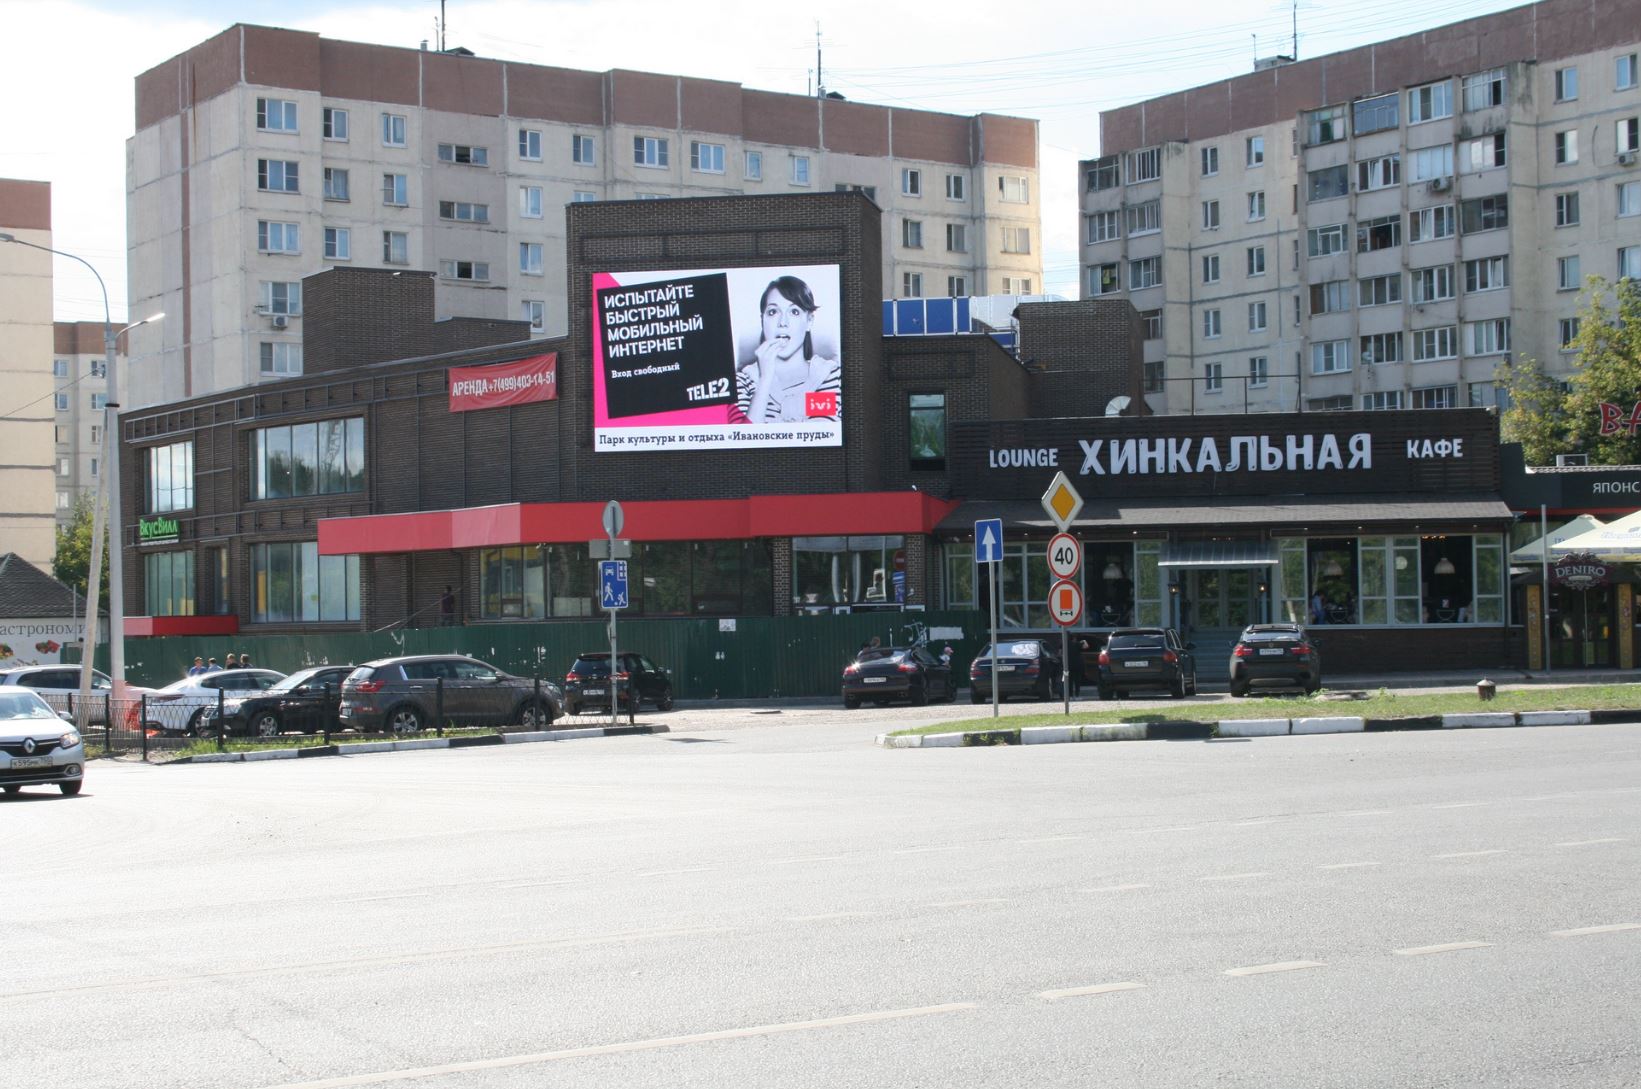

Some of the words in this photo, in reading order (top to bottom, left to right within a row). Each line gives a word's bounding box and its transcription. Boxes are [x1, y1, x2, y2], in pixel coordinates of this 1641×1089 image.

[604, 284, 694, 309] ИСПЫТАЙТЕ
[606, 301, 680, 325] БЫСТРЫЙ
[607, 314, 703, 342] МОБИЛЬНЫЙ
[609, 336, 685, 358] ИНТЕРНЕТ
[611, 369, 632, 379] Вход
[633, 362, 681, 376] свободный
[452, 378, 488, 397] АРЕНДА
[686, 377, 731, 401] TELE2
[810, 398, 831, 411] ivi
[599, 434, 625, 447] Парк
[627, 435, 676, 446] культуры
[688, 433, 725, 443] отдыха
[728, 431, 794, 441] «Ивановские
[796, 431, 835, 442] пруды»
[1406, 438, 1464, 458] КАФЕ
[989, 448, 1059, 468] LOUNGE
[1078, 432, 1372, 476] ХИНКАЛЬНАЯ
[1054, 546, 1074, 565] 40
[1554, 564, 1606, 578] DENIRO
